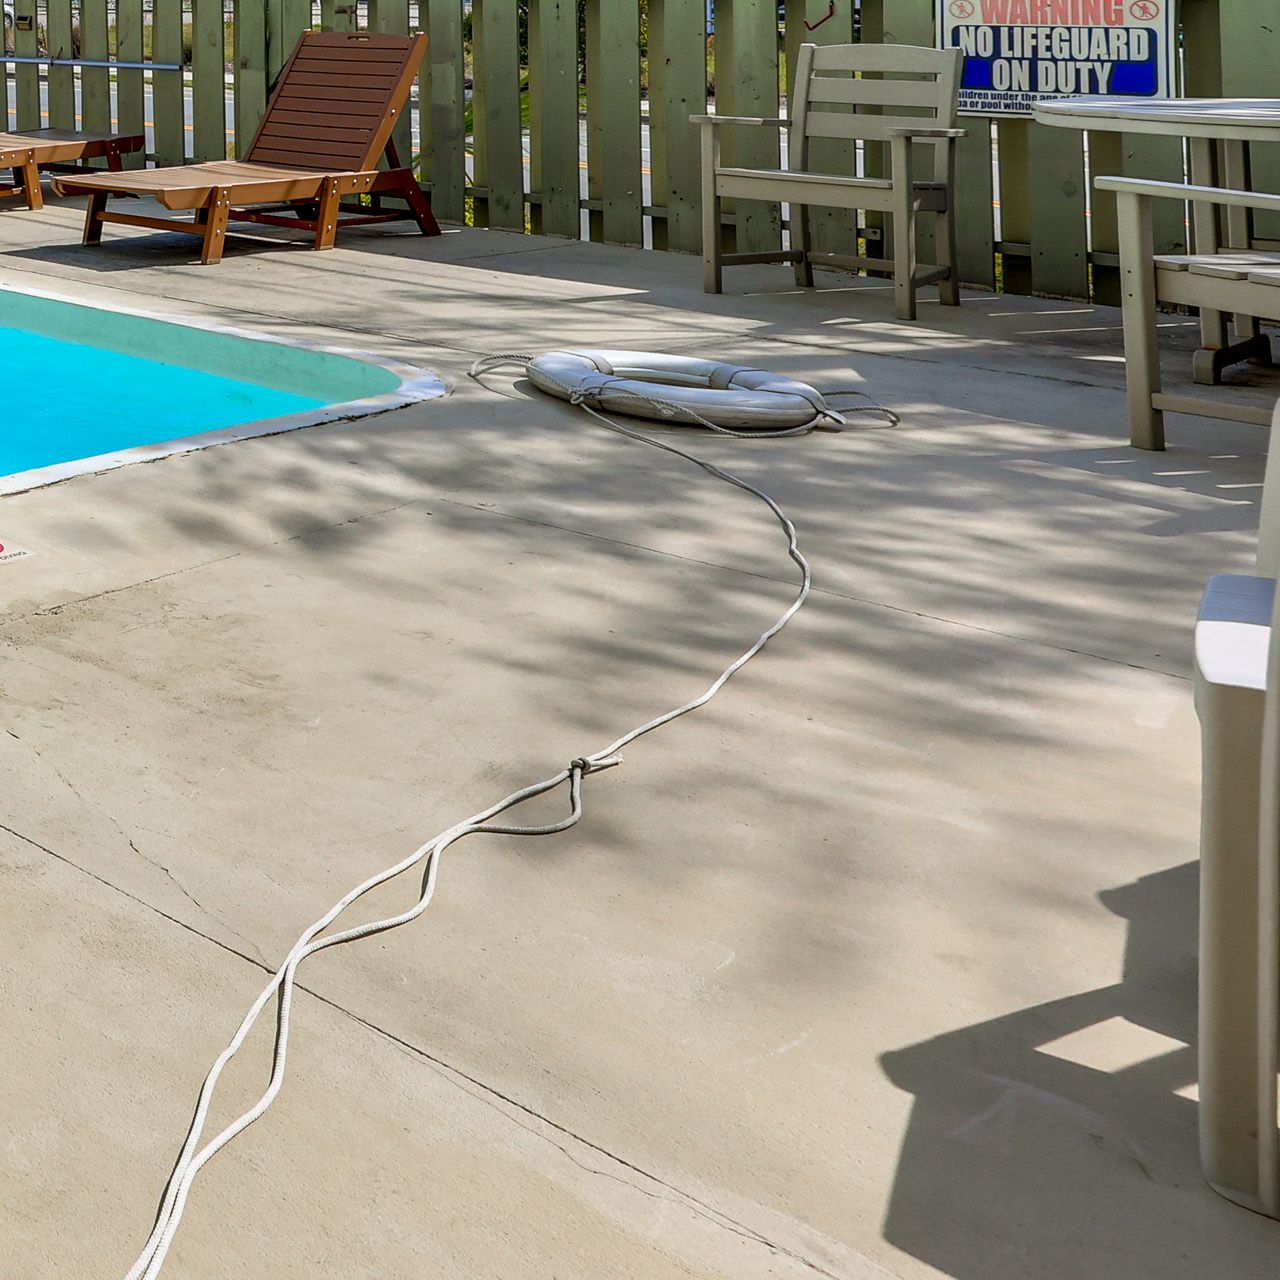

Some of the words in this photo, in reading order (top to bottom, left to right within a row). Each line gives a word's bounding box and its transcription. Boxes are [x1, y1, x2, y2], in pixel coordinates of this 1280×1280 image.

[959, 26, 994, 57] NO
[1000, 27, 1149, 61] LIFEGUARD
[992, 59, 1030, 91] ON
[1037, 61, 1113, 95] DUTY
[969, 100, 979, 109] or
[981, 101, 1001, 110] pool
[990, 92, 1019, 101] under
[1021, 93, 1038, 102] the
